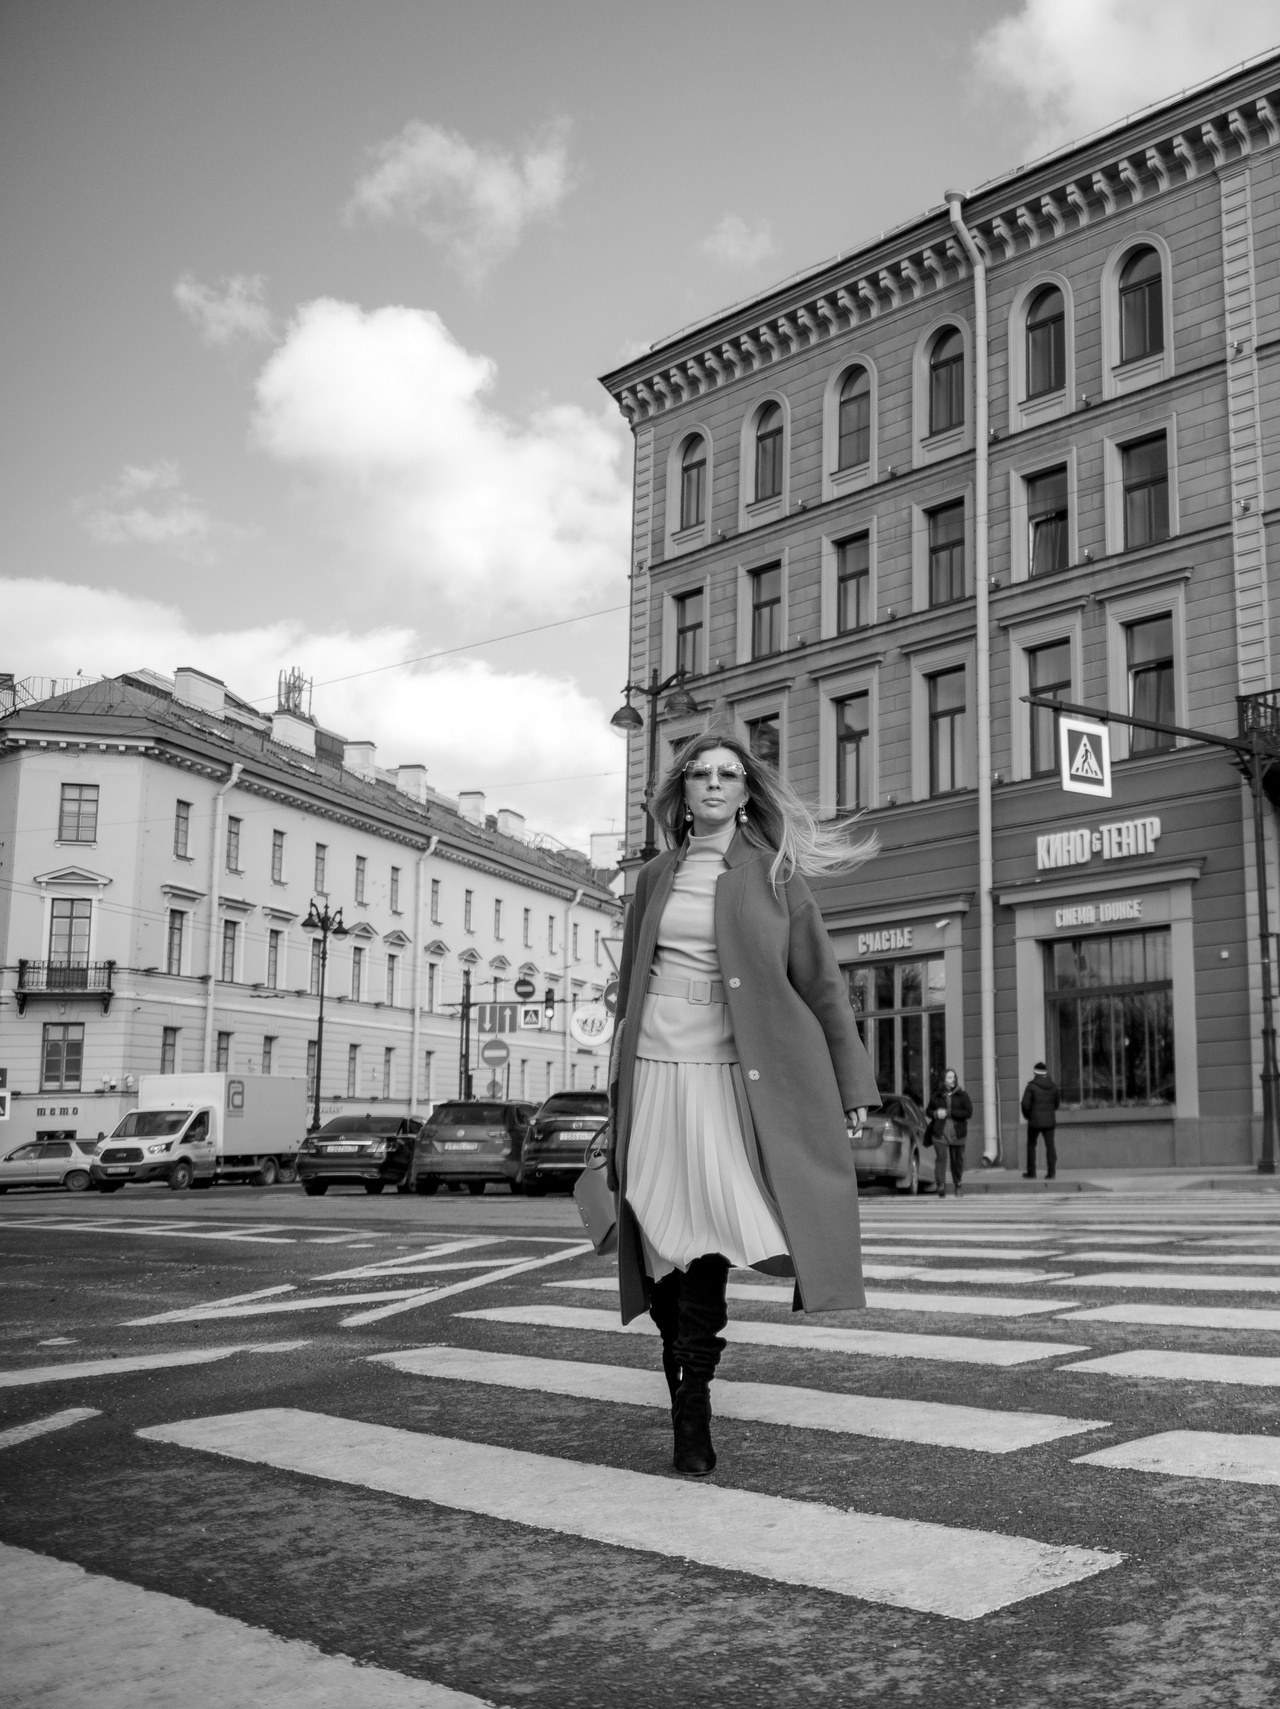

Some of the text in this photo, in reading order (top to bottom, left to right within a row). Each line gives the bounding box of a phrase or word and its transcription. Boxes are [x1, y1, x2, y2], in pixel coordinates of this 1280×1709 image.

[1056, 899, 1142, 927] CINEMA LOUNGE
[858, 927, 913, 954] СЧАСТЬЕ
[37, 1107, 79, 1117] memo
